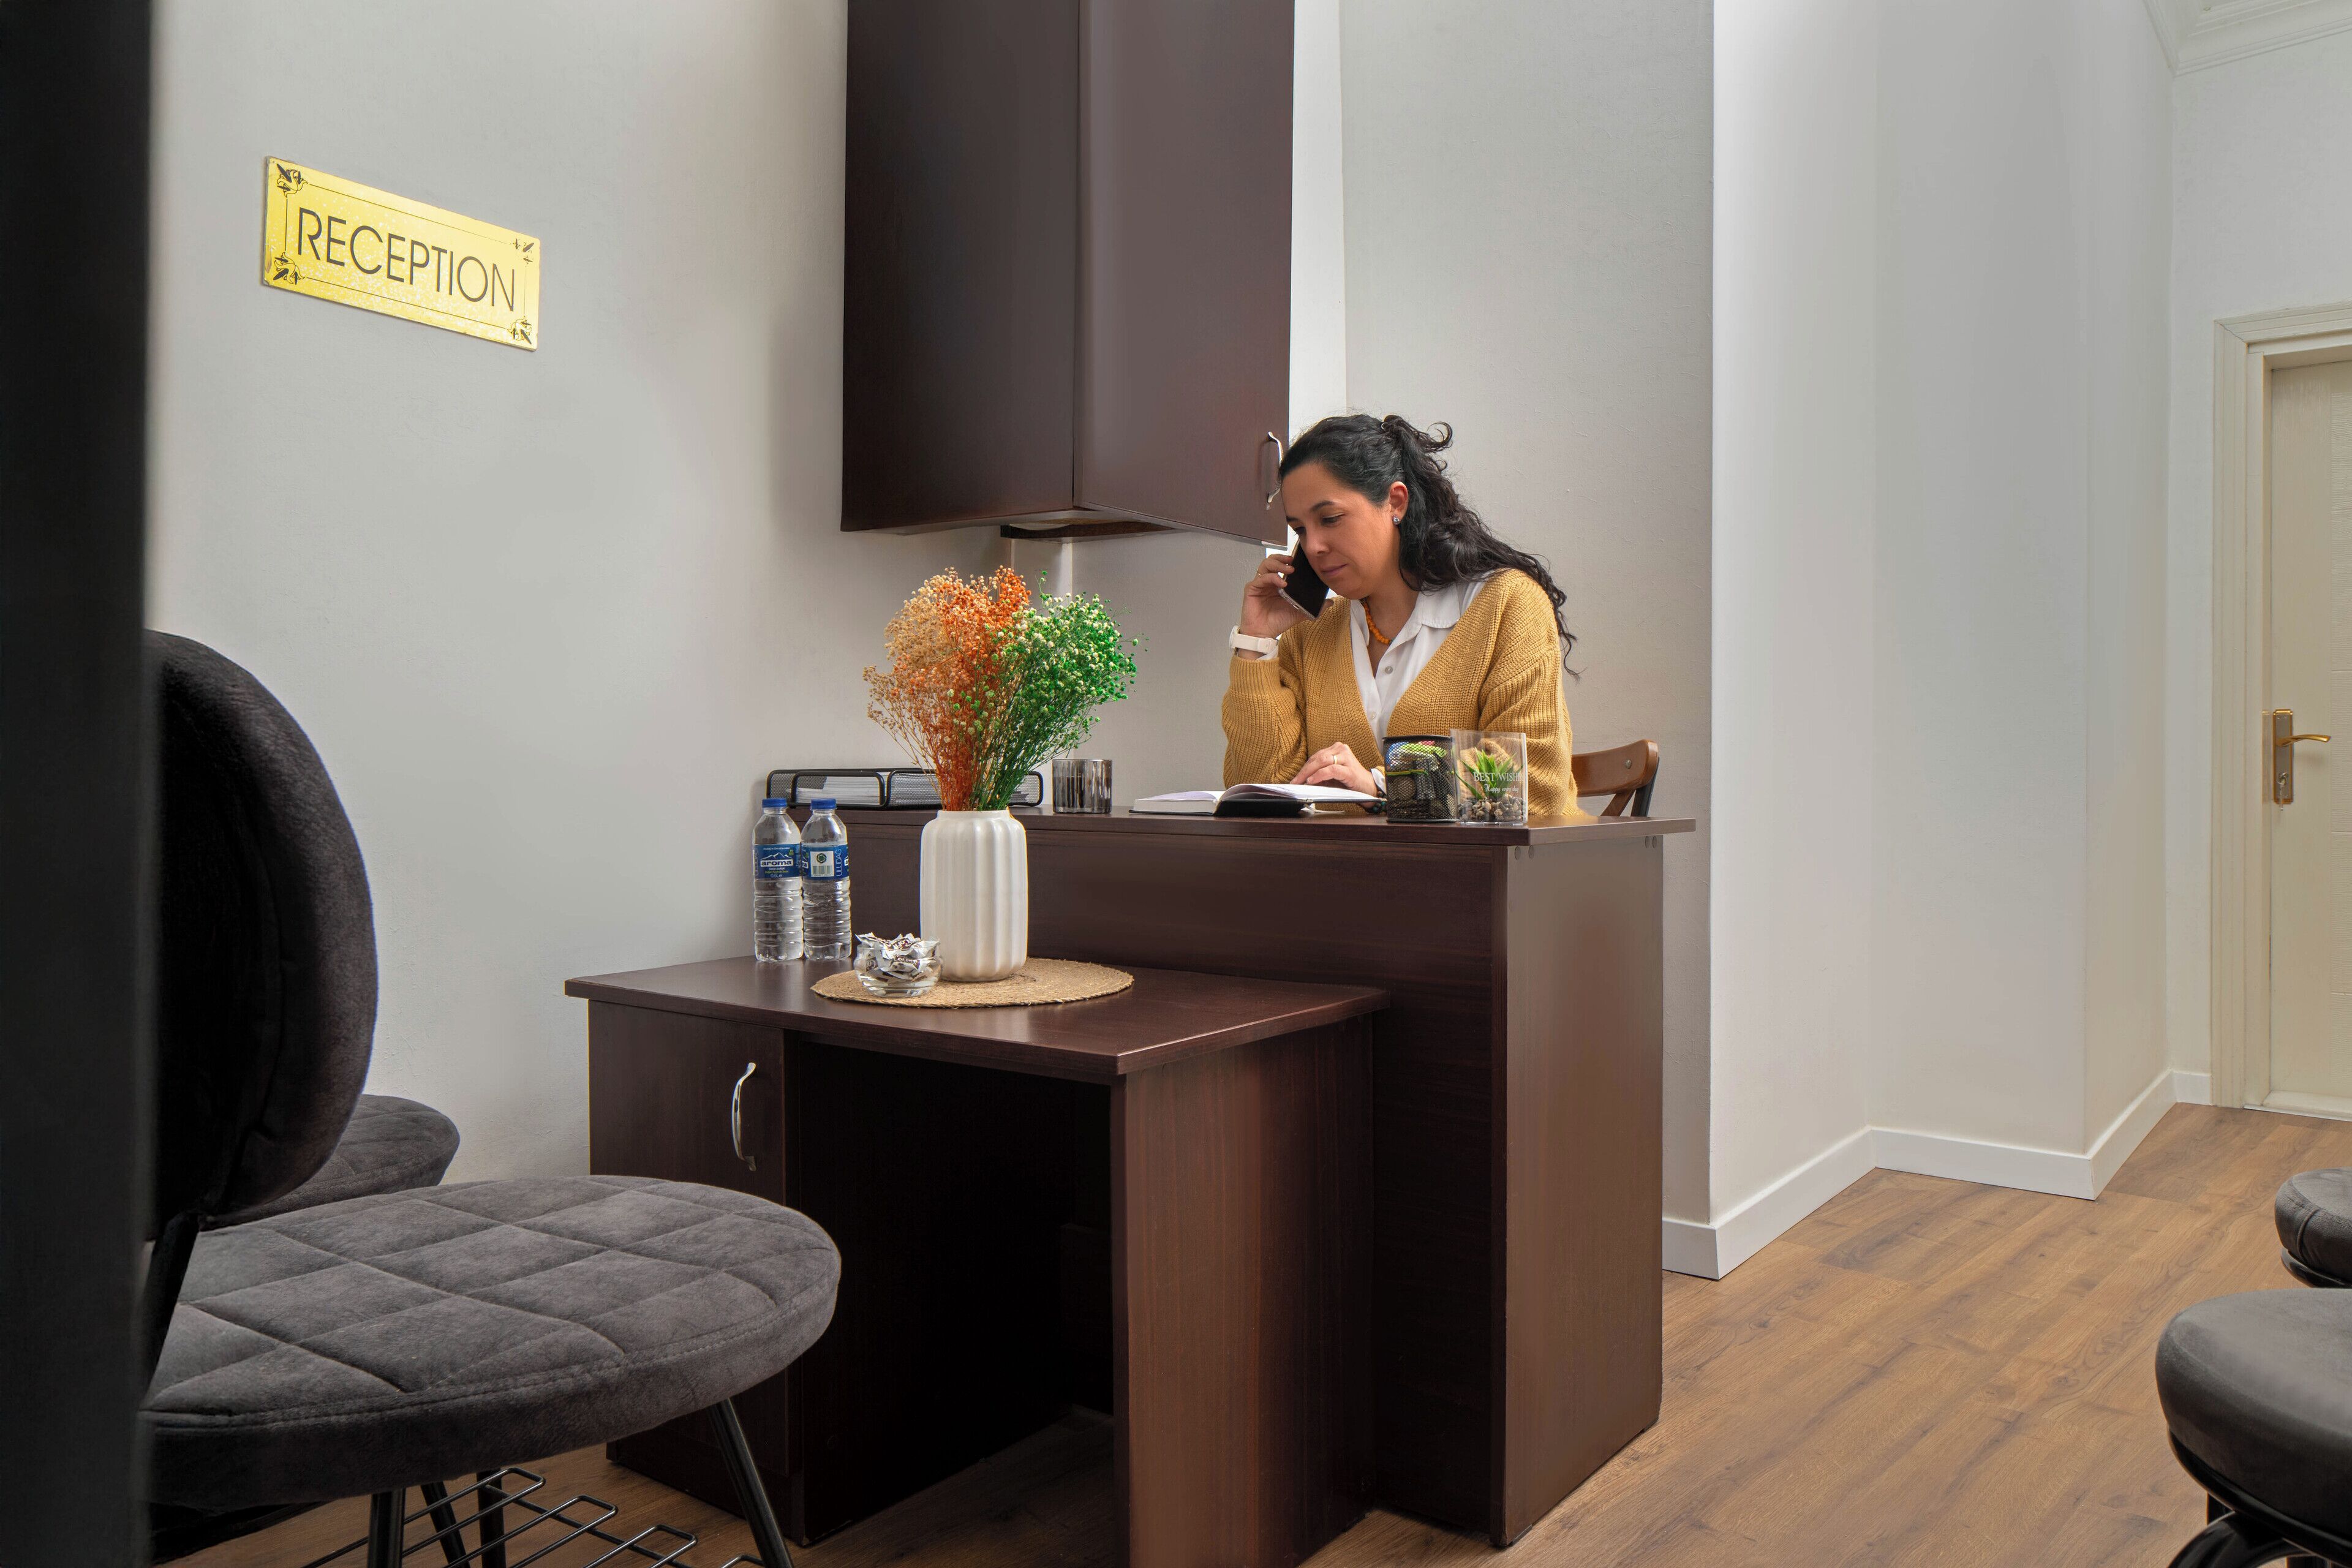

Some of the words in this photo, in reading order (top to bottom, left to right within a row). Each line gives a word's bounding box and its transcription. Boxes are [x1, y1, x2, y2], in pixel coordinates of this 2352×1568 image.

[298, 207, 514, 312] RECEPTION
[1473, 772, 1494, 782] BEST
[1483, 783, 1500, 793] Happy
